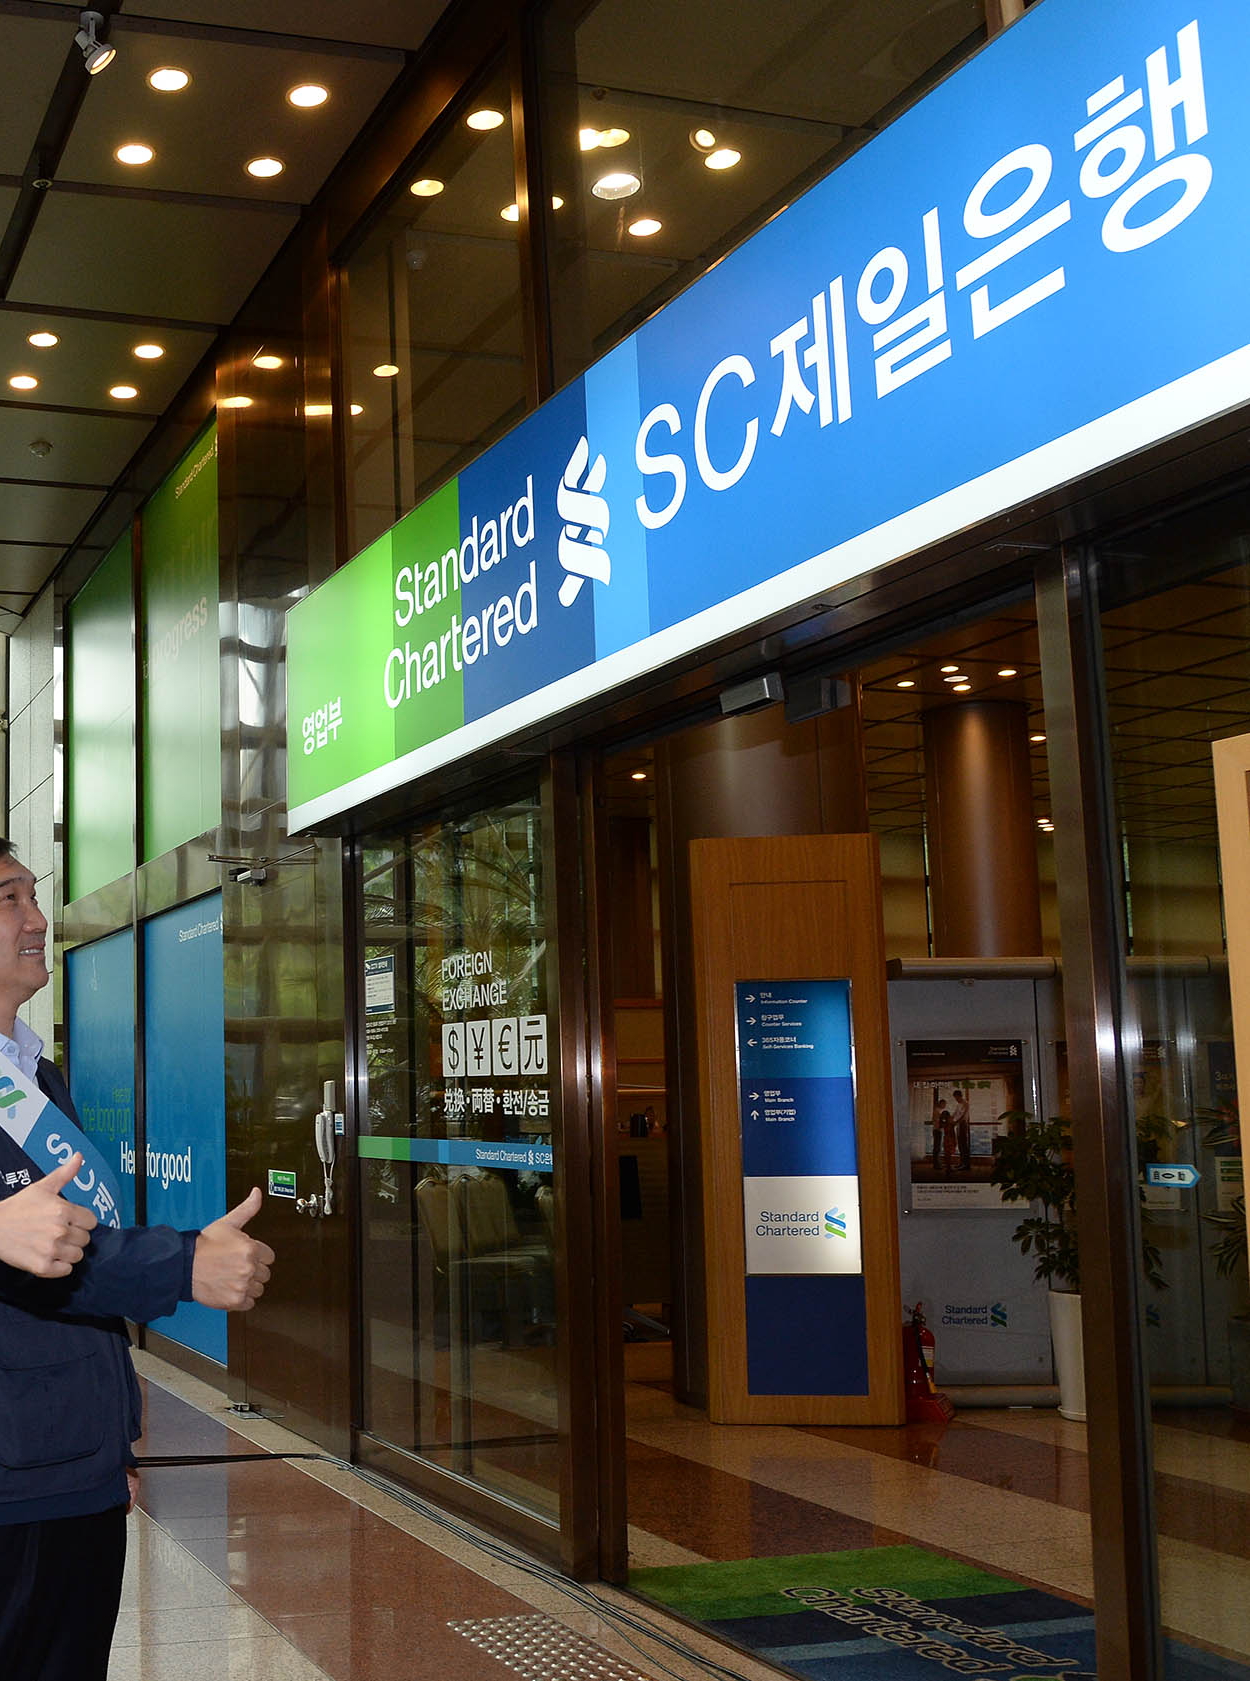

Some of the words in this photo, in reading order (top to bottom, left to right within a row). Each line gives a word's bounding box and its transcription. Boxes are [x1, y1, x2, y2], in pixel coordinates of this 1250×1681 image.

[635, 19, 1213, 530] SC제일은행
[395, 474, 535, 627] Standard
[383, 560, 538, 709] Chartered
[302, 696, 343, 755] 영업부
[441, 950, 493, 981] FOREIGN
[442, 980, 508, 1011] EXCHANGE
[146, 1143, 161, 1178] for
[161, 1145, 191, 1190] good
[475, 1147, 500, 1161] Standard
[499, 1149, 527, 1163] Chartered
[755, 1224, 820, 1237] Chartered
[760, 1210, 820, 1223] Standard
[941, 1315, 988, 1325] Chartered
[944, 1304, 988, 1314] Standard
[779, 1585, 1015, 1674] Chartered
[850, 1586, 1080, 1667] Standard
